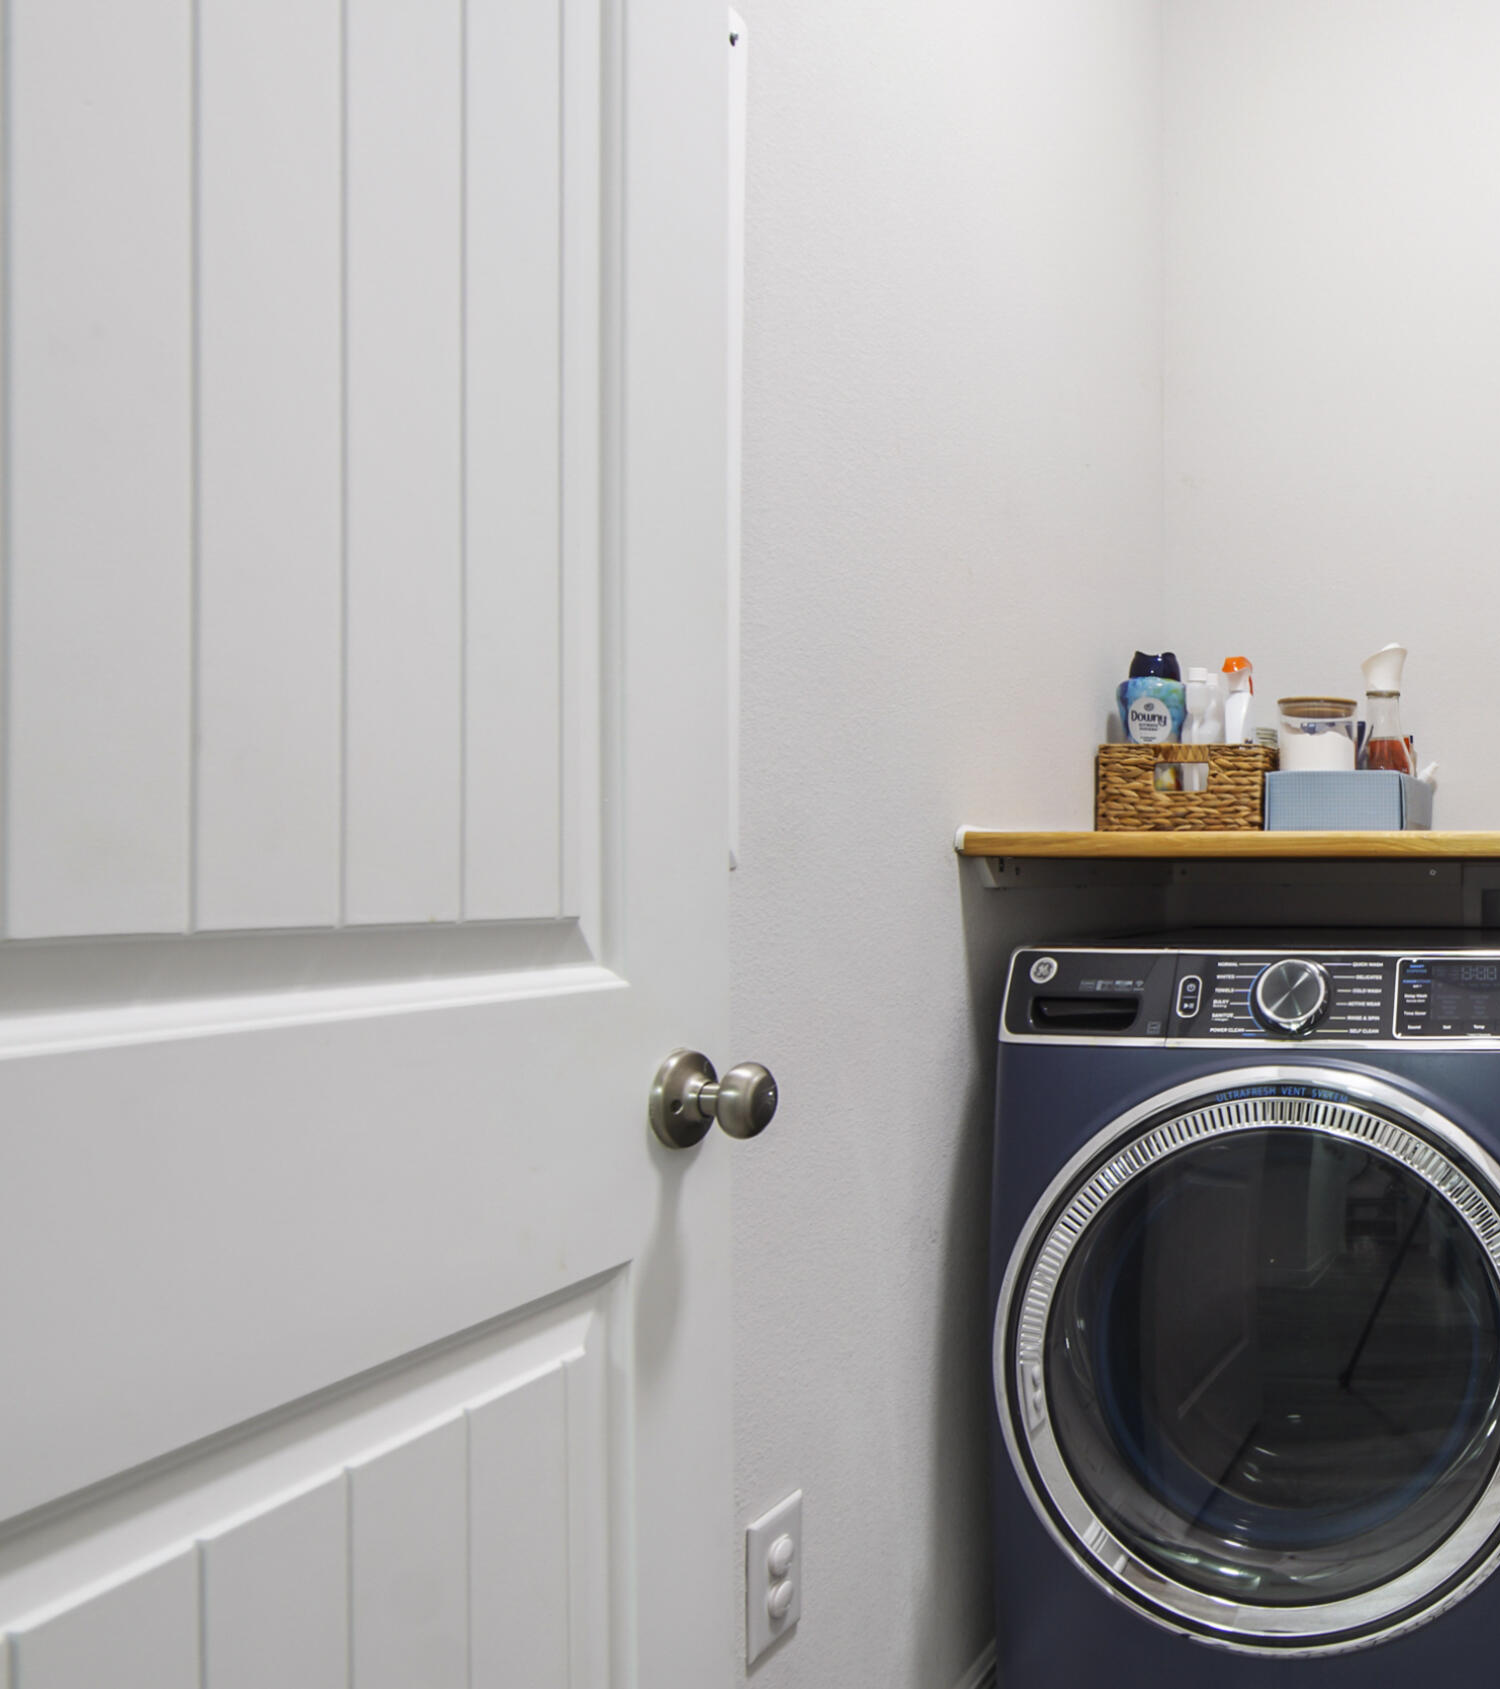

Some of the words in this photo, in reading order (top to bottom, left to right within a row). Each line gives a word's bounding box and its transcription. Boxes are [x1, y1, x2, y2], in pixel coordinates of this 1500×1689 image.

[1131, 710, 1167, 727] Downy
[1216, 1087, 1277, 1102] ULTRAFRESH
[1280, 1087, 1307, 1097] VENT
[1312, 1088, 1348, 1103] SYSTEM
